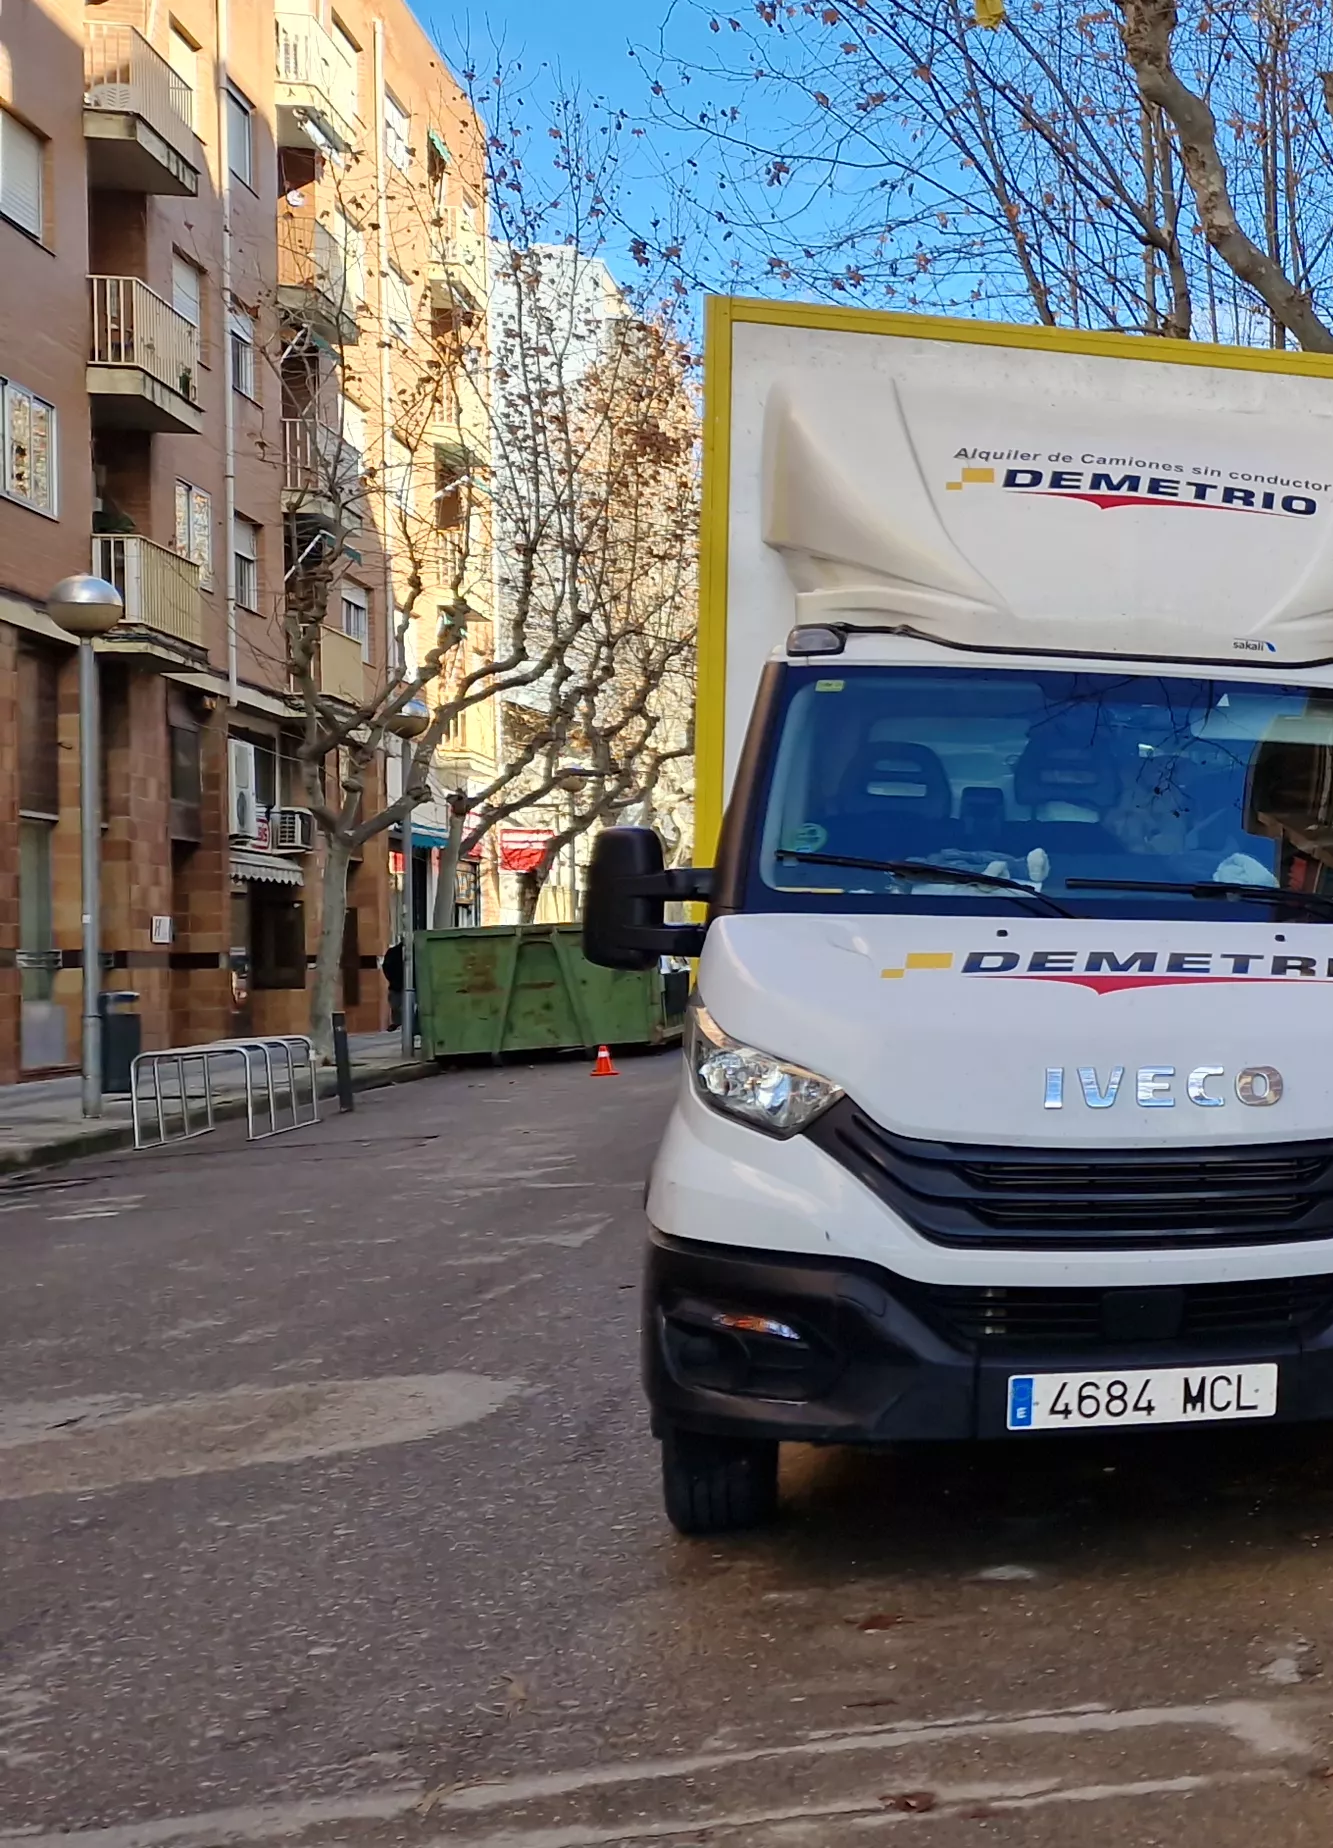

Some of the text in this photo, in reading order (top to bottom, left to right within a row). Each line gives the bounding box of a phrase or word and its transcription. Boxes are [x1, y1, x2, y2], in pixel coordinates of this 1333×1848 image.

[954, 446, 1332, 492] Alquiler de Camiones sin conductor
[1002, 467, 1318, 517] DEMETRIO
[1043, 1065, 1284, 1110] IVECO
[1016, 1374, 1259, 1420] E 4684 MCL
